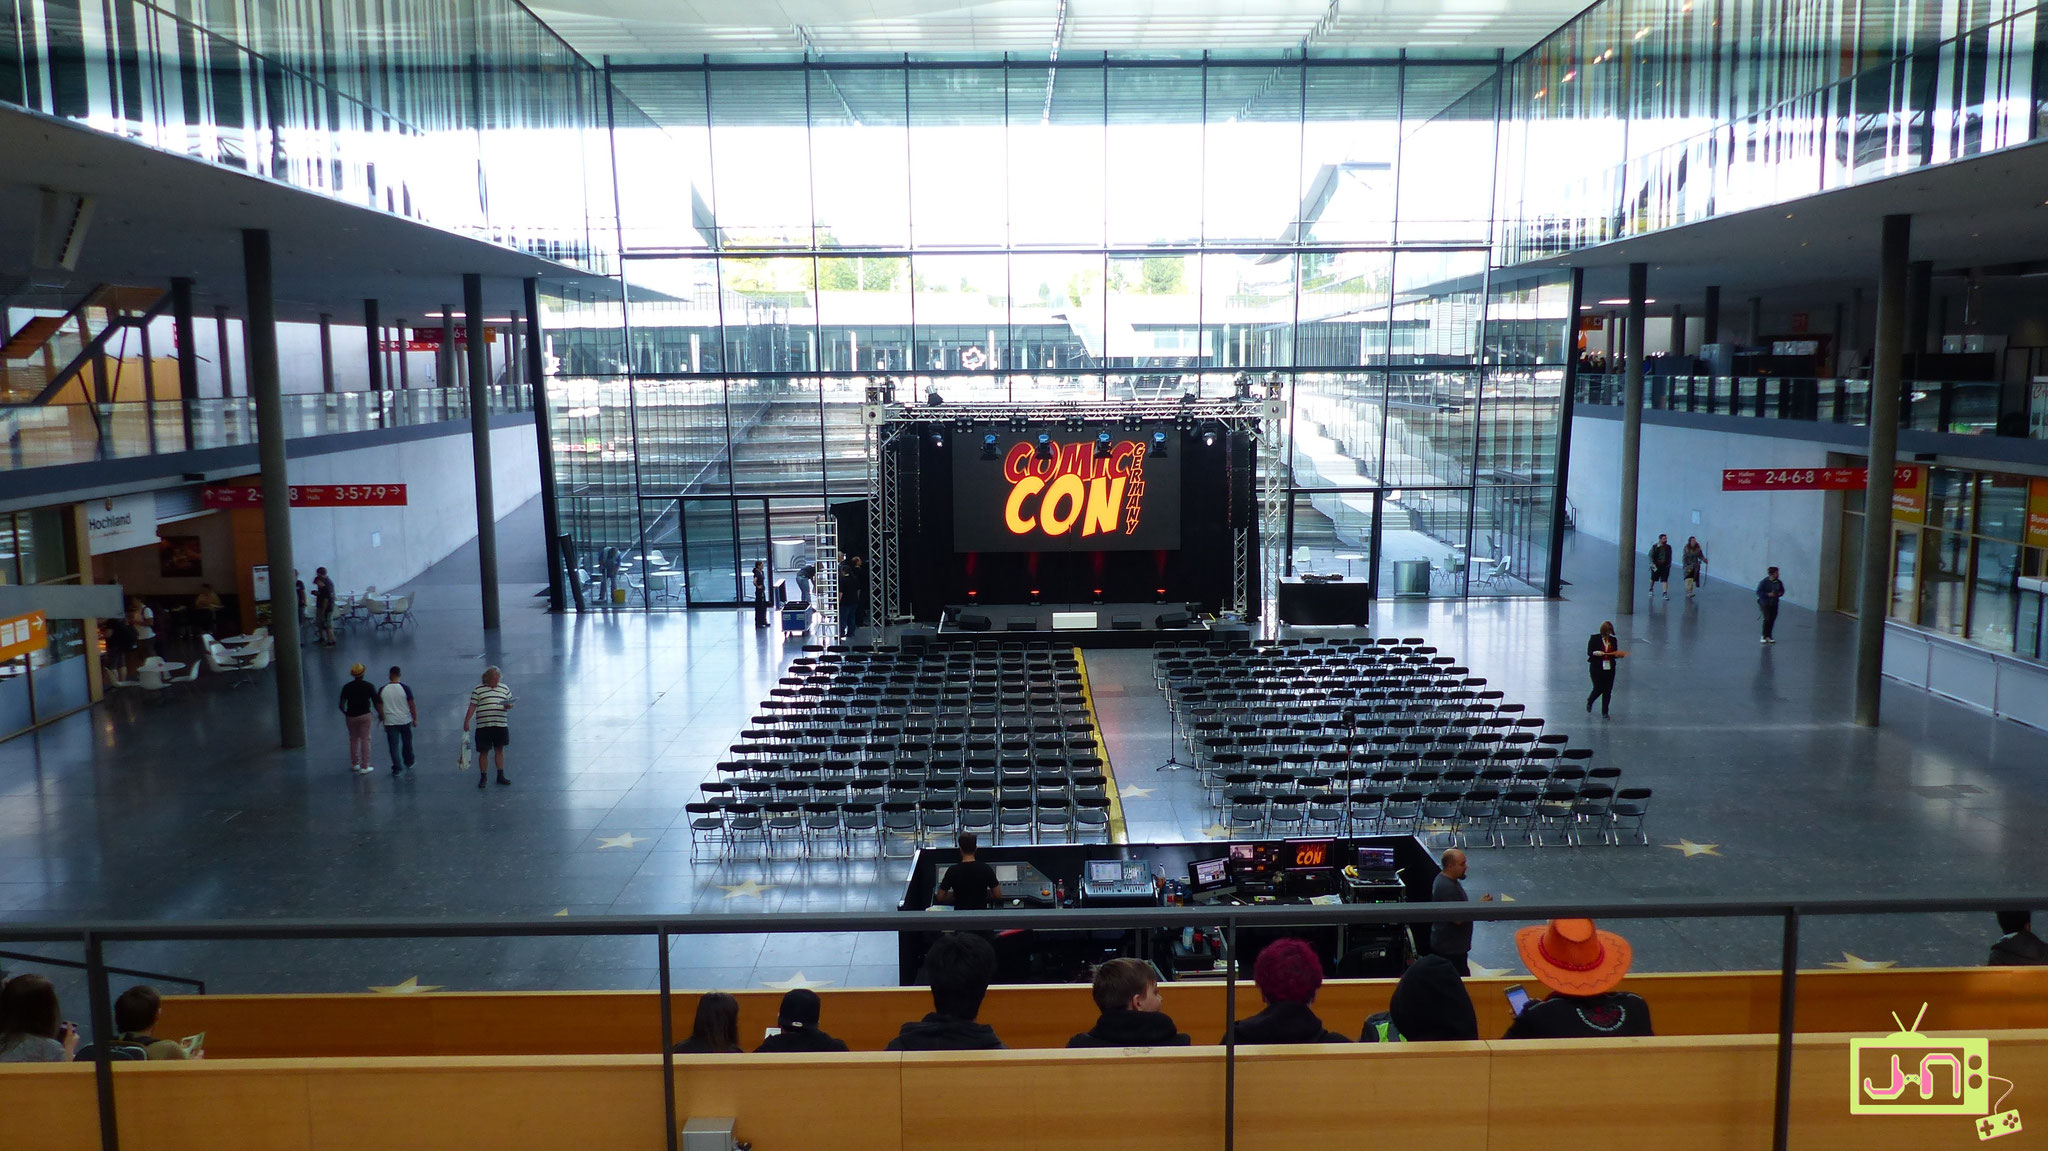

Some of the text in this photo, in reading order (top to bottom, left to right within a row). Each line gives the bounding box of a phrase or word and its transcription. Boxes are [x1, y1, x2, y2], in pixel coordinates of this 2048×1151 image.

[1004, 441, 1135, 484] COMIC
[1004, 475, 1128, 537] CON
[1126, 442, 1146, 535] GERMANY
[89, 512, 132, 531] Hochland
[1296, 851, 1322, 865] CON
